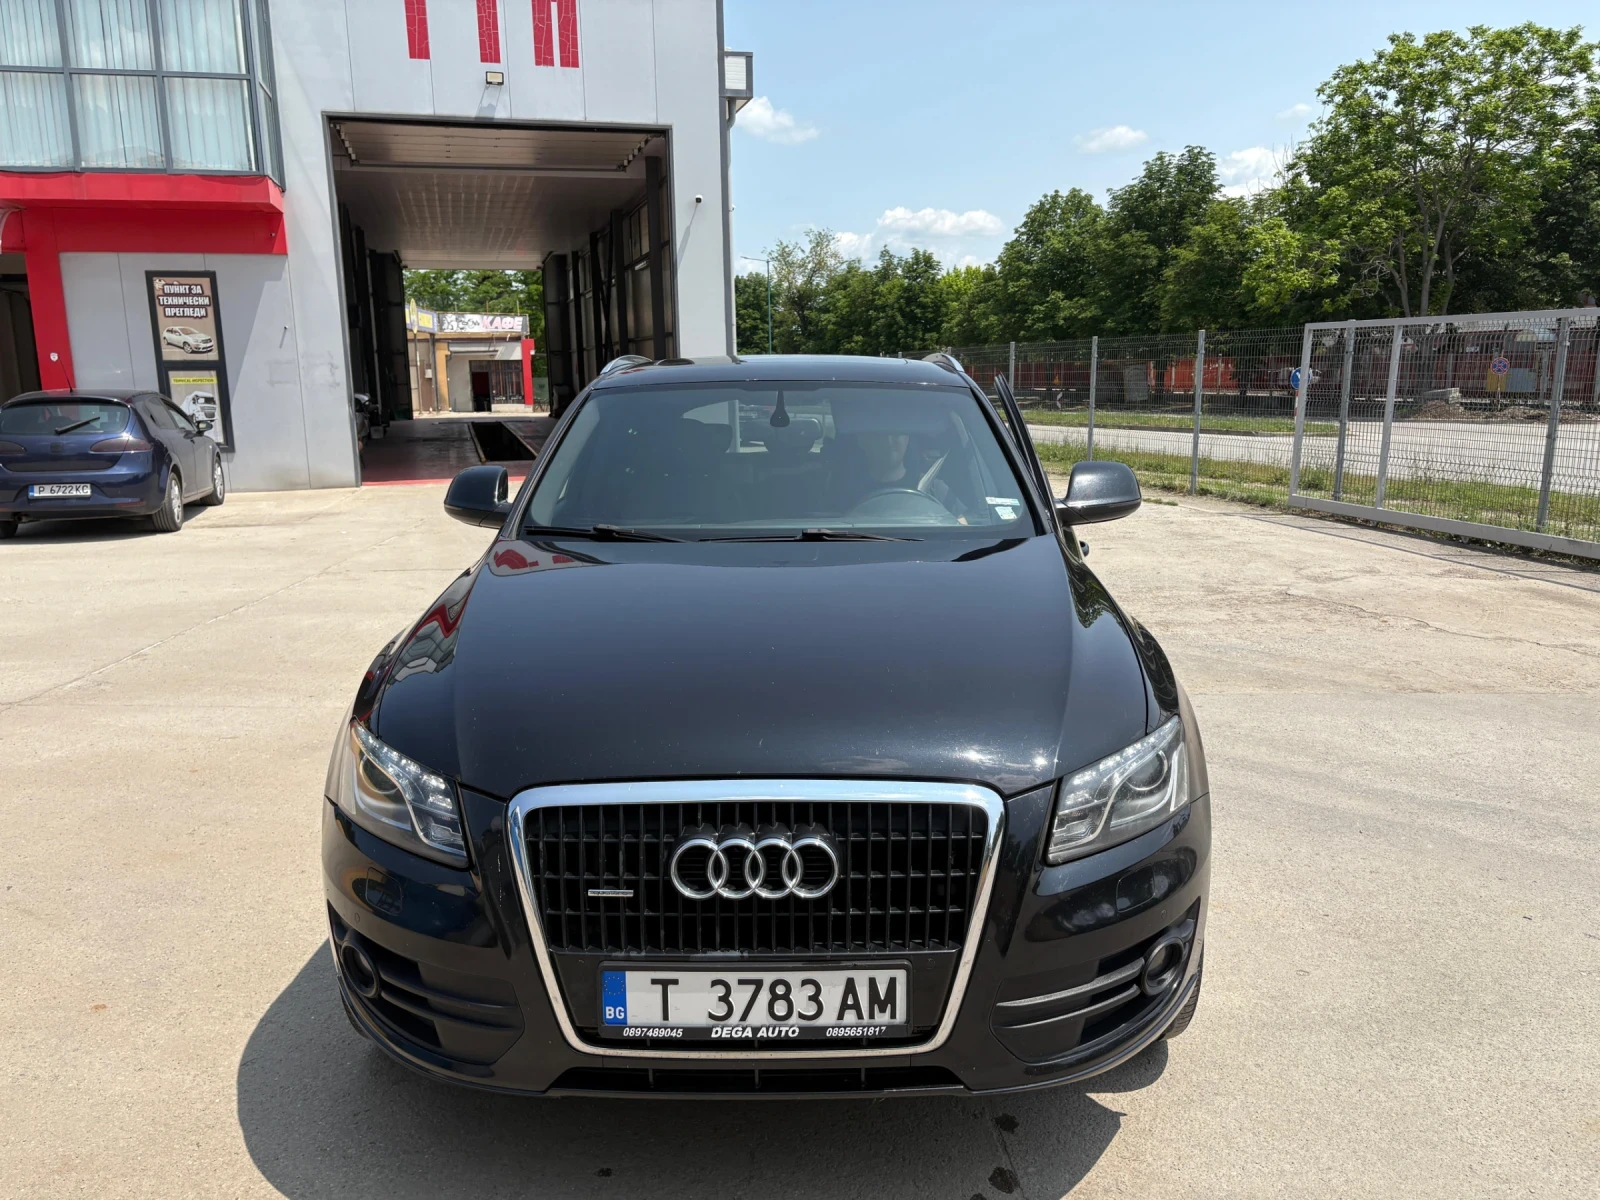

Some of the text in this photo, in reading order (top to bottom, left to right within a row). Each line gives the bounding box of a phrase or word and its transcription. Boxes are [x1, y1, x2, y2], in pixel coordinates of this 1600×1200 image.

[163, 285, 203, 294] ПУНКТ ЗА
[158, 296, 210, 306] ТЕХНИЧЕСКИ
[165, 307, 207, 317] ПРЕГЛЕДИ
[482, 315, 523, 330] КАФЕ
[38, 486, 45, 495] P
[650, 976, 897, 1022] T 3783 AM
[605, 1006, 625, 1019] BG
[622, 1026, 887, 1038] 0897489045 DEGA AUTO 0895651817
